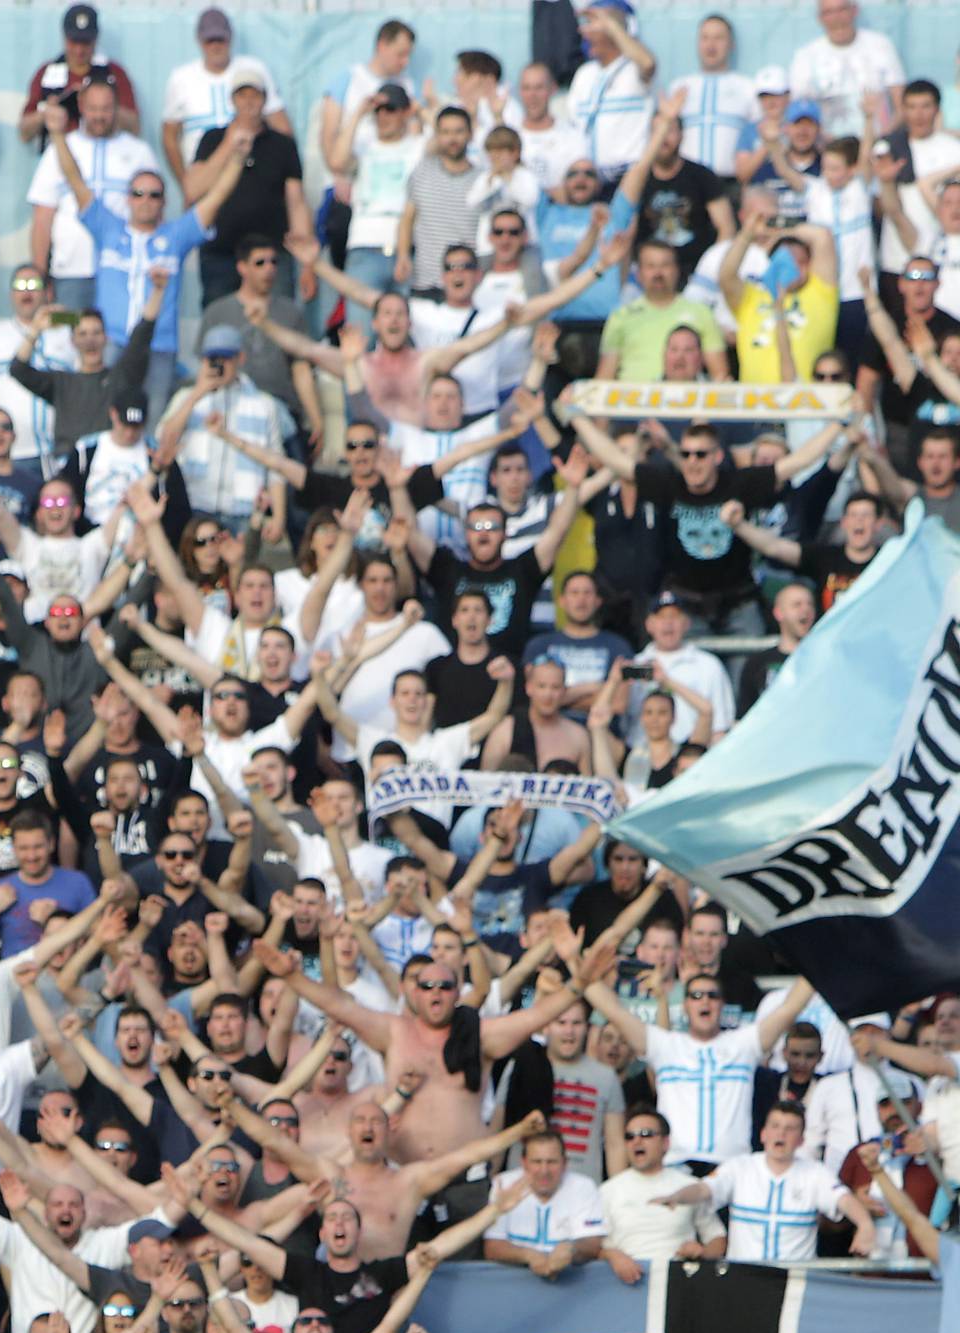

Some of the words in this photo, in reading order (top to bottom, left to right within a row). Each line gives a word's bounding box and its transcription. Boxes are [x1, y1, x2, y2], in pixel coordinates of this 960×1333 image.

[607, 390, 825, 410] RIJEKA
[373, 776, 470, 801] ARMADA
[522, 780, 611, 809] RIJEKA
